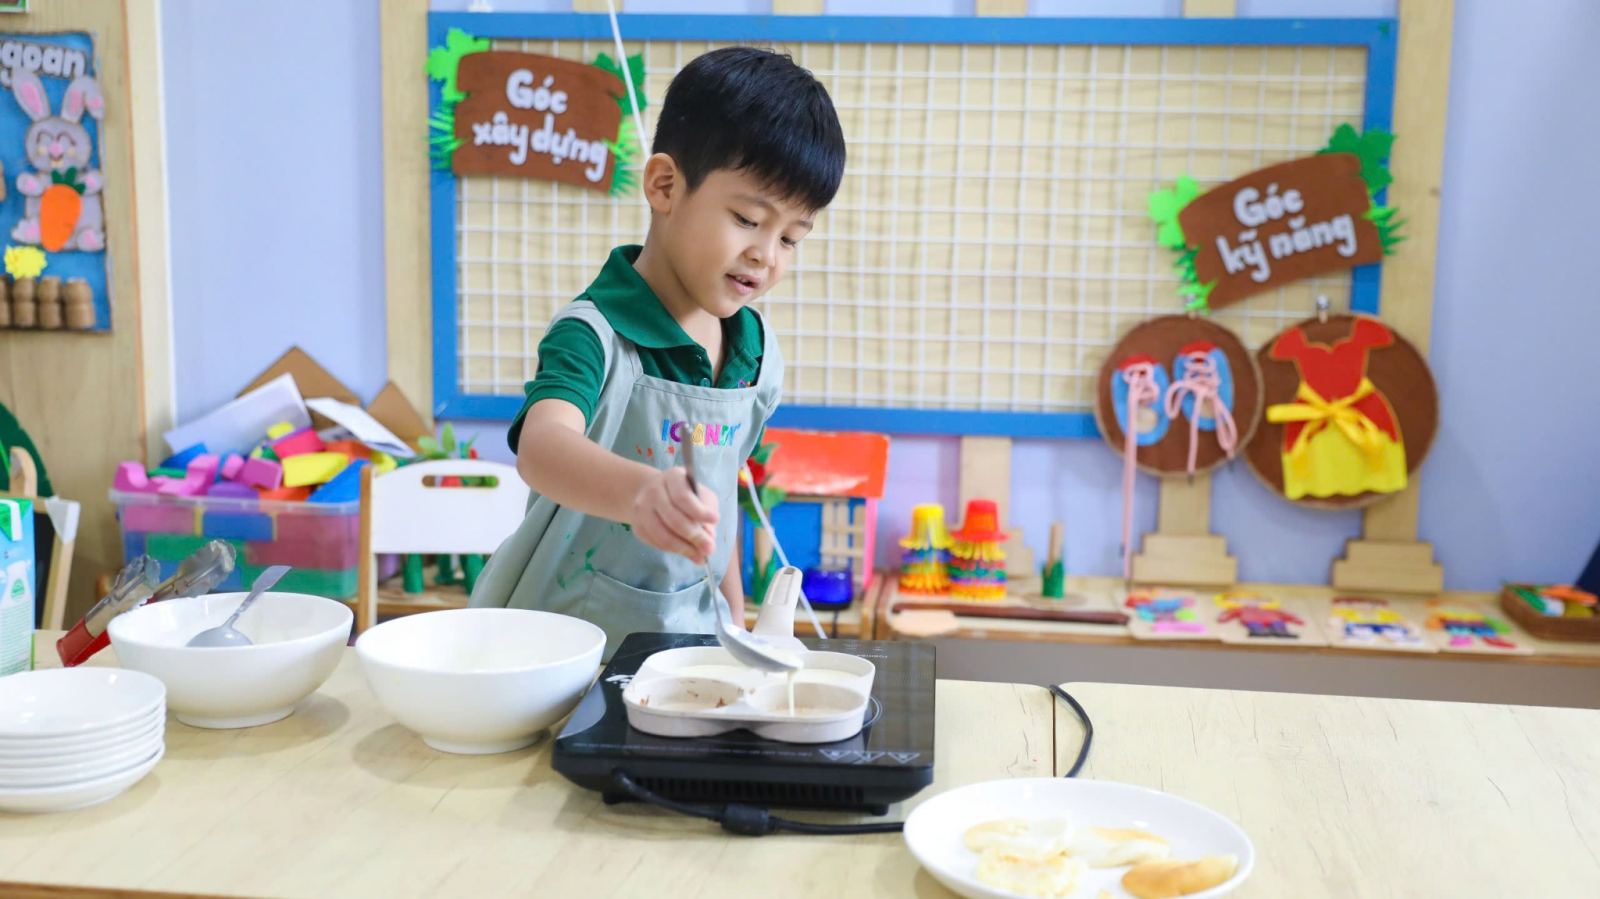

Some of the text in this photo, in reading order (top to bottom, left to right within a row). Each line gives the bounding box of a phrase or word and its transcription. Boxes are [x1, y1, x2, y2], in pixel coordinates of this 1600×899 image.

[0, 40, 86, 87] goan
[506, 68, 568, 114] Góc
[472, 111, 608, 182] xây dựng
[1233, 183, 1304, 227] Góc
[1215, 214, 1357, 282] kỹ năng
